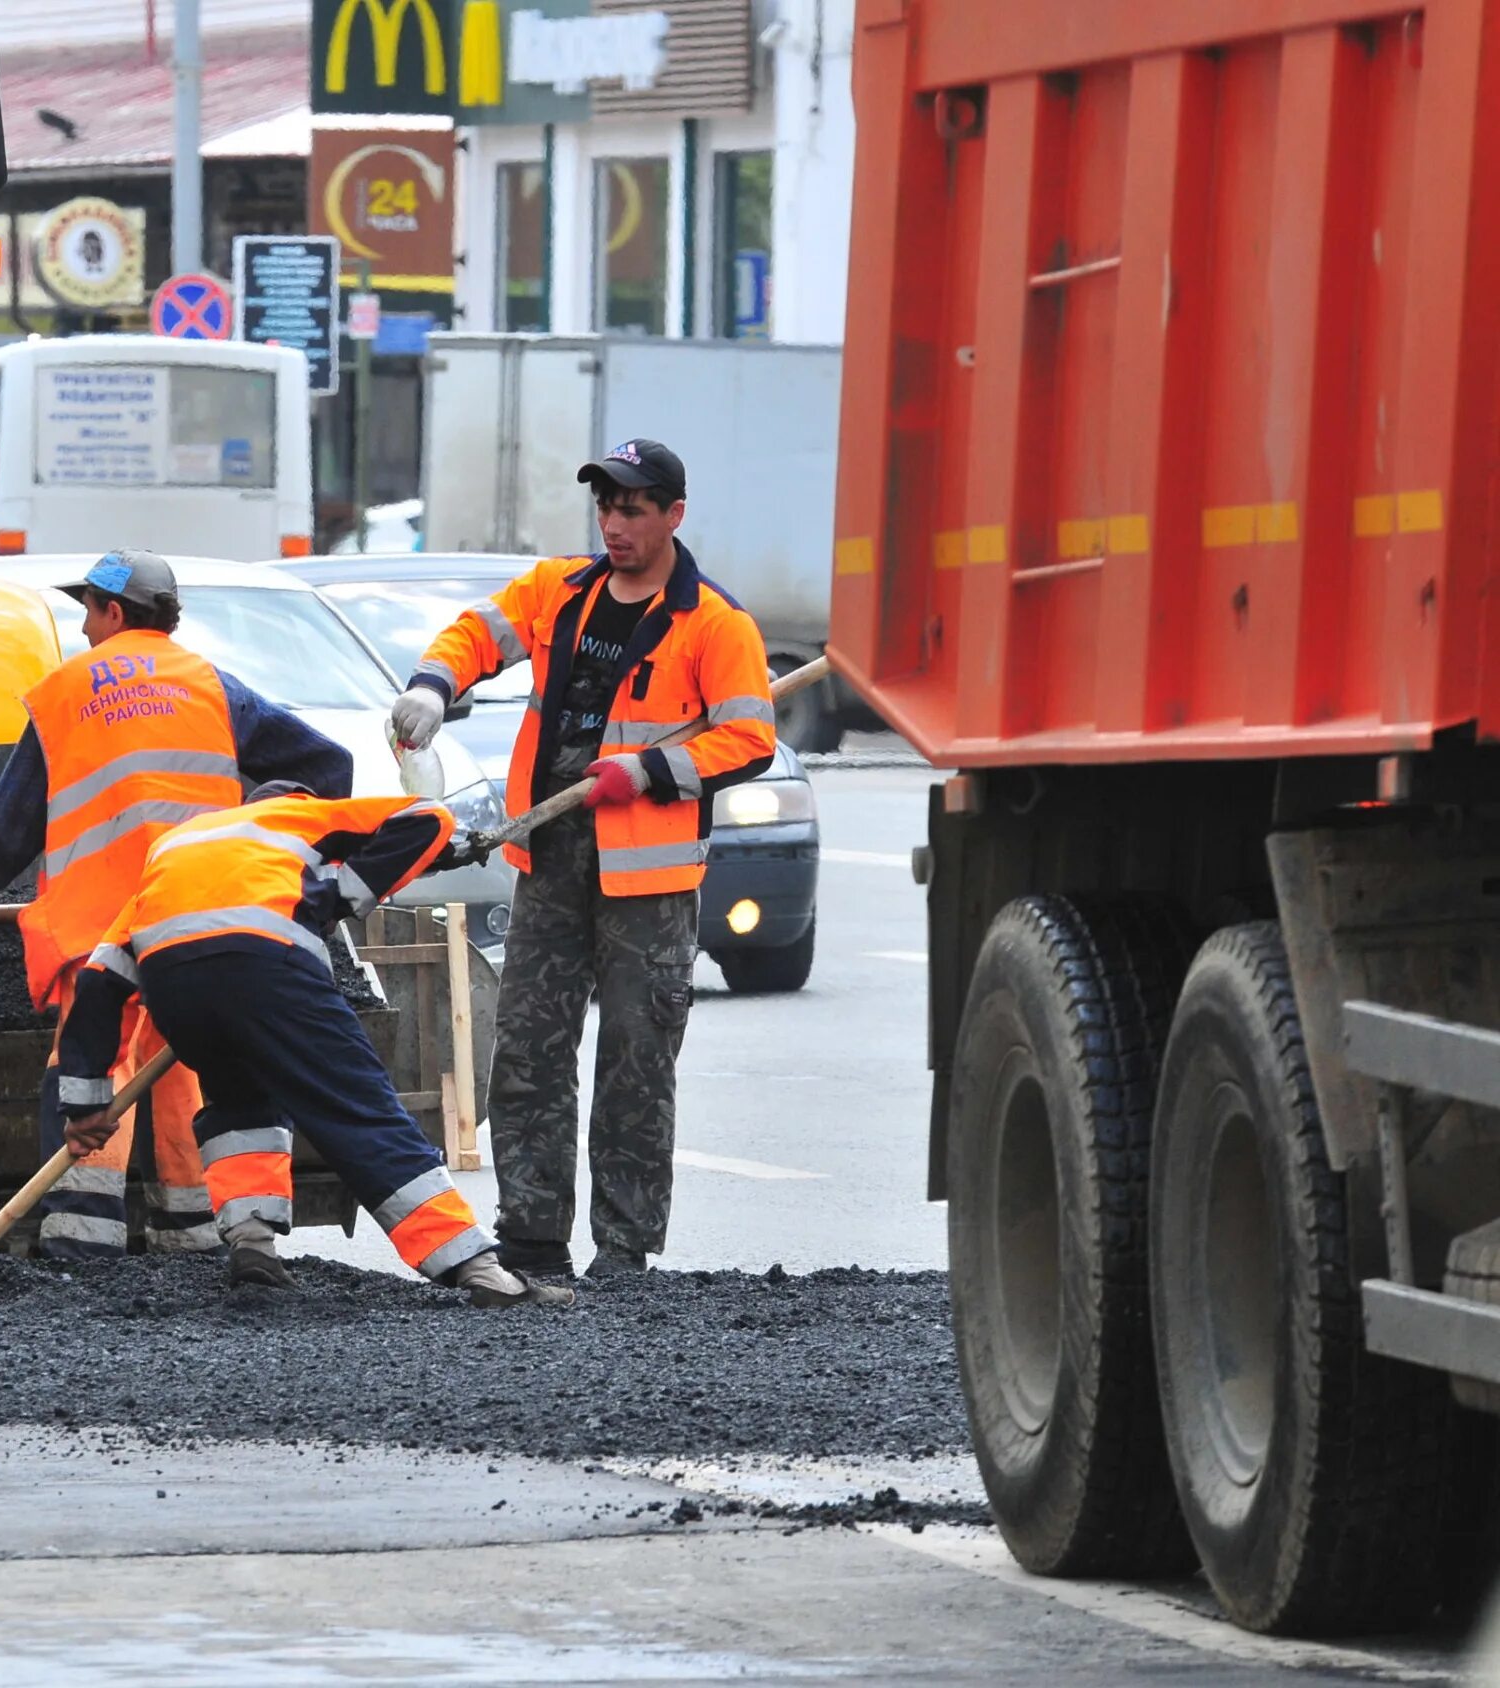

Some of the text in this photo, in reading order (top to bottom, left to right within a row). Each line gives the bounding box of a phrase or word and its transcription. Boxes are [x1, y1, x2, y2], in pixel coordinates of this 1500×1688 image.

[367, 179, 418, 216] 24
[88, 655, 157, 694] ДЭУ
[79, 684, 190, 722] ЛЕНИНСКОГО
[104, 701, 175, 727] РАЙОНА
